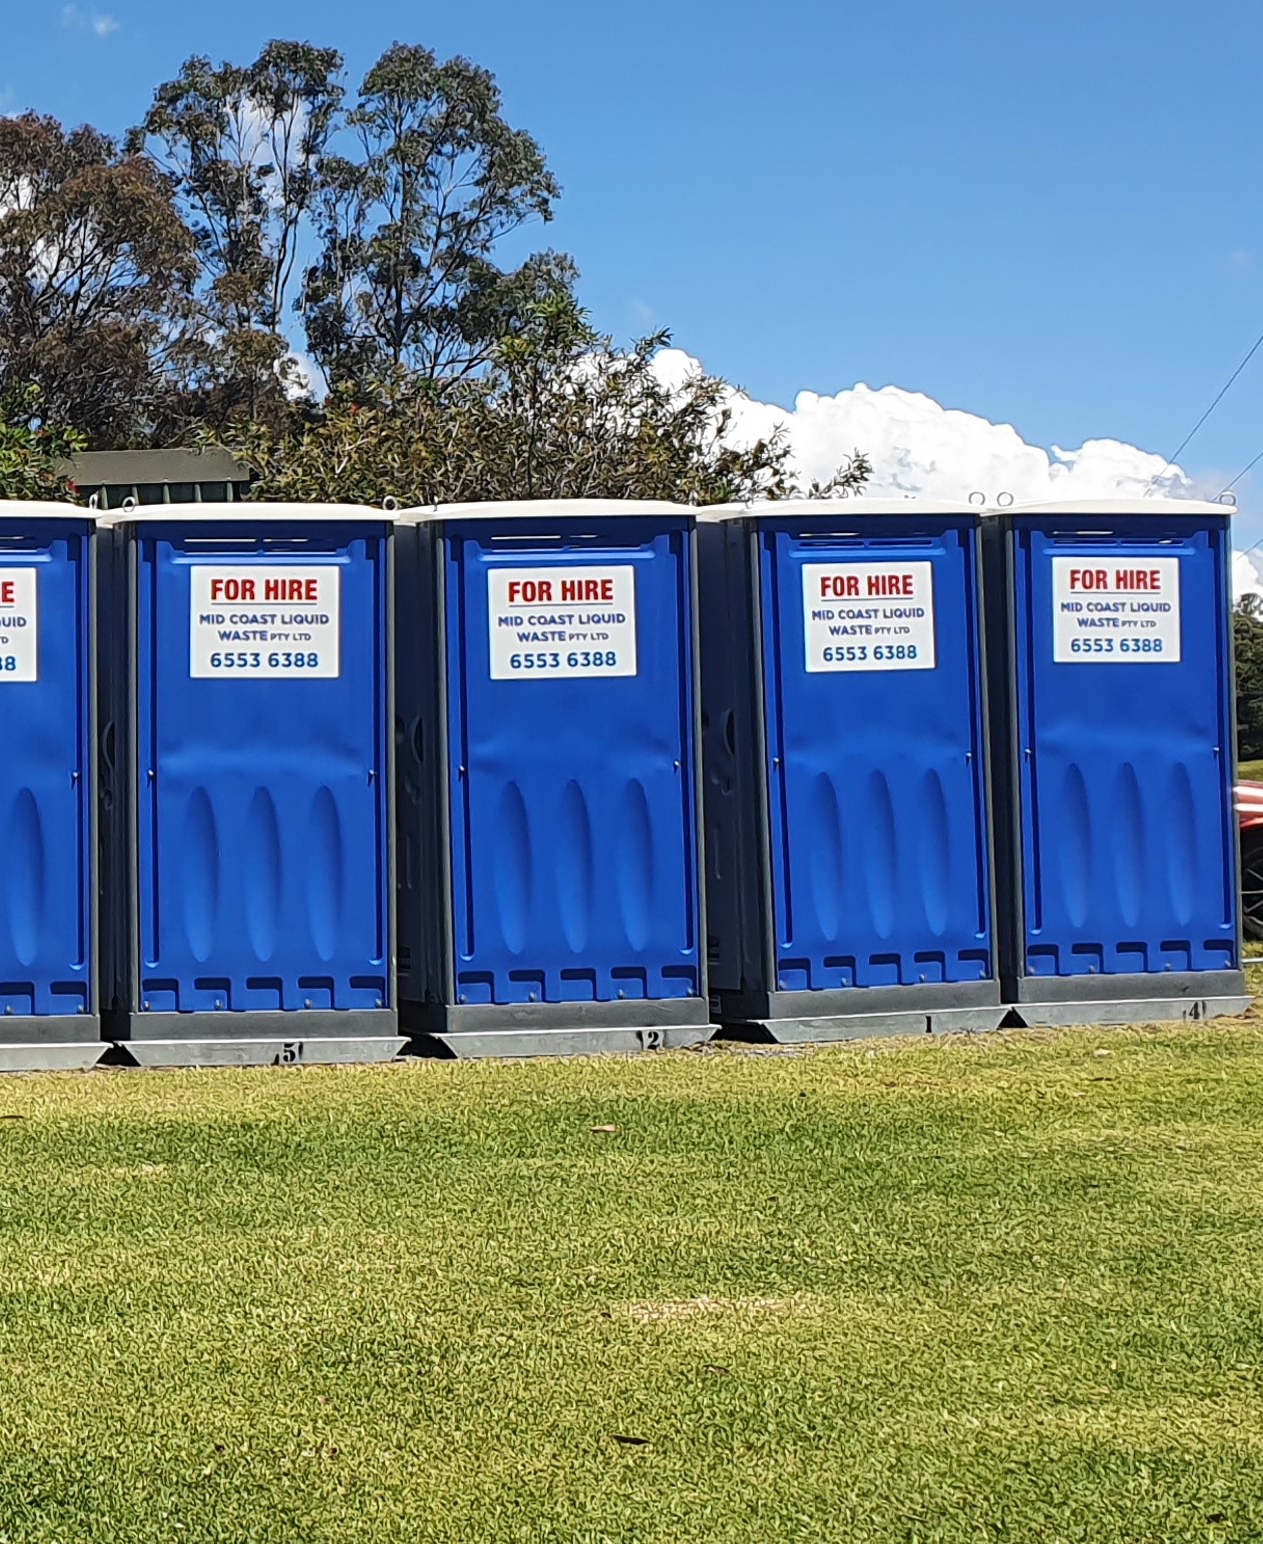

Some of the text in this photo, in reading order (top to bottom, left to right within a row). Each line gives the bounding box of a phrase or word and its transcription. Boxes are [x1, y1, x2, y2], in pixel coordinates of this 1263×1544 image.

[820, 574, 914, 598] FOR HIRE
[1069, 569, 1161, 590] FOR HIRE
[210, 578, 318, 601] FOR HIRE
[508, 578, 614, 603] FOR HIRE
[811, 607, 925, 621] MID COAST LIQUID
[1060, 601, 1172, 613] MID COAST LIQUID
[199, 613, 330, 625] MID COAST LIQUID
[497, 612, 626, 628] MID COAST LIQUID
[1076, 617, 1157, 628] WASTE PTY LTD
[217, 629, 312, 642] WASTE PTY LTD
[516, 630, 609, 643] WASTE PTY LTD
[828, 624, 911, 636] WASTE PTY LTD
[822, 644, 918, 663] 6553 6388
[1070, 638, 1163, 653] 6553 6388
[210, 652, 319, 669] 6553 6388
[509, 650, 617, 670] 6553 6388
[647, 1031, 660, 1050] 2
[283, 1042, 296, 1062] 5
